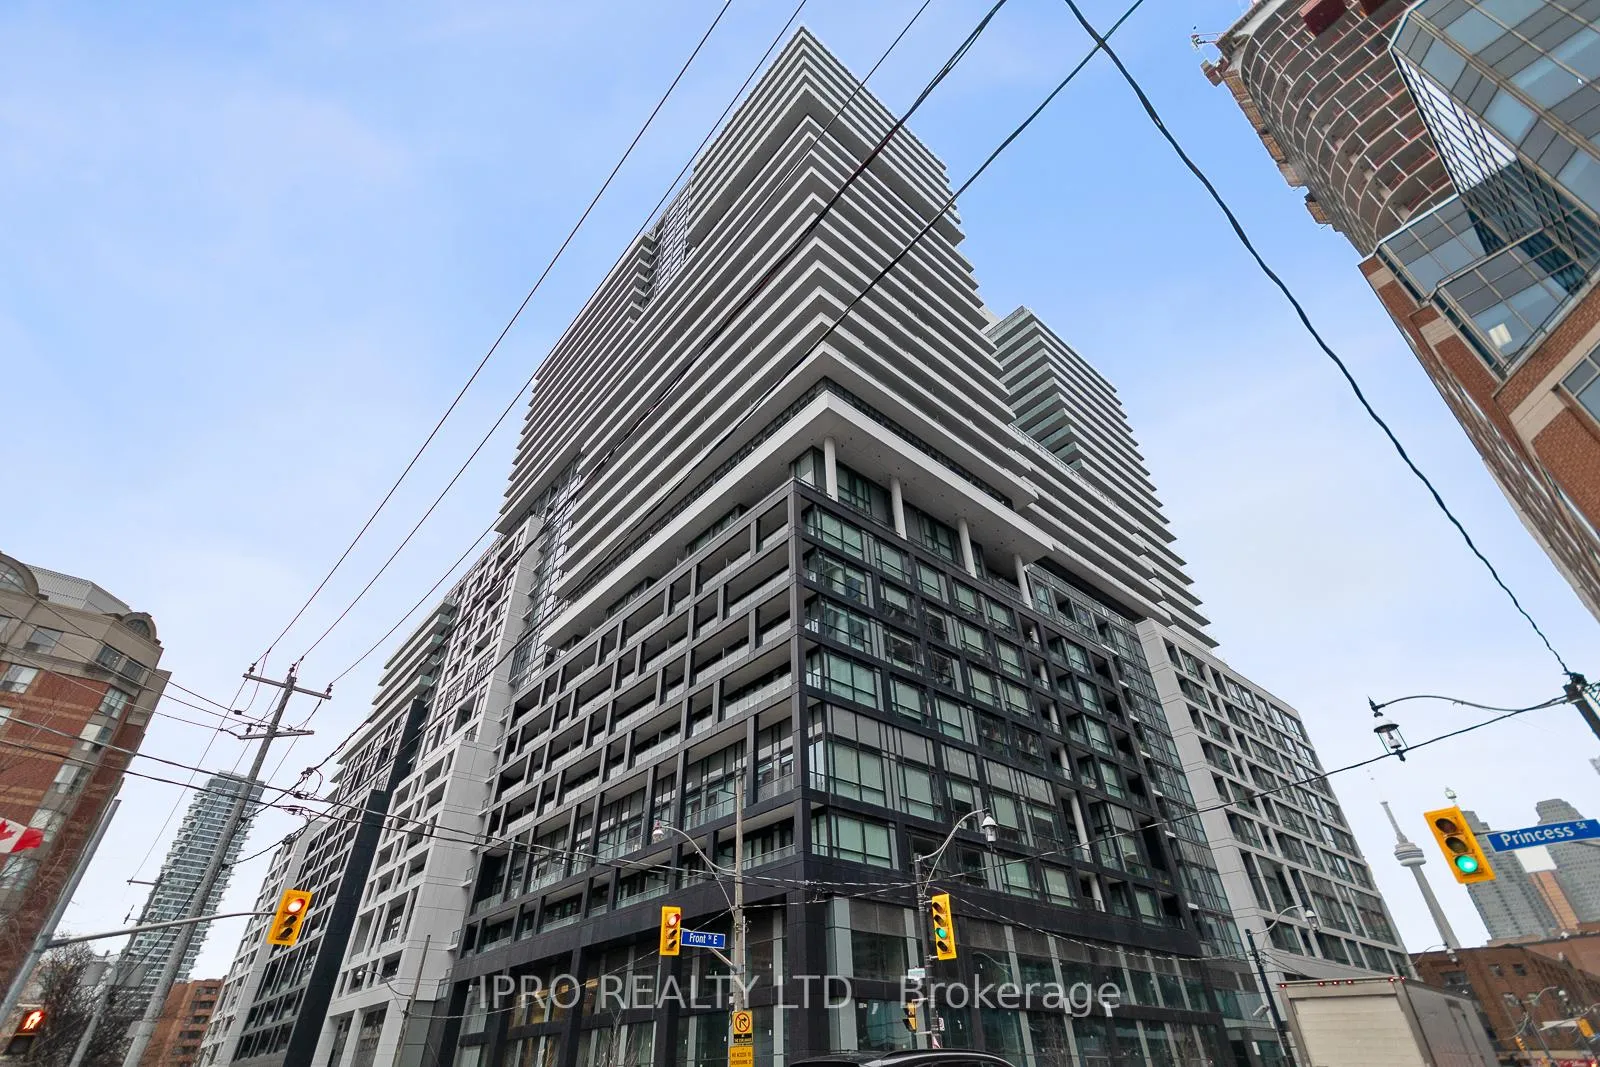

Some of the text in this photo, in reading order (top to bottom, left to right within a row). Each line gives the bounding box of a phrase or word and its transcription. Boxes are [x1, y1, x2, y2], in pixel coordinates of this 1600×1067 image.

[1500, 826, 1575, 847] Princess
[690, 932, 706, 944] Front
[713, 935, 718, 944] E
